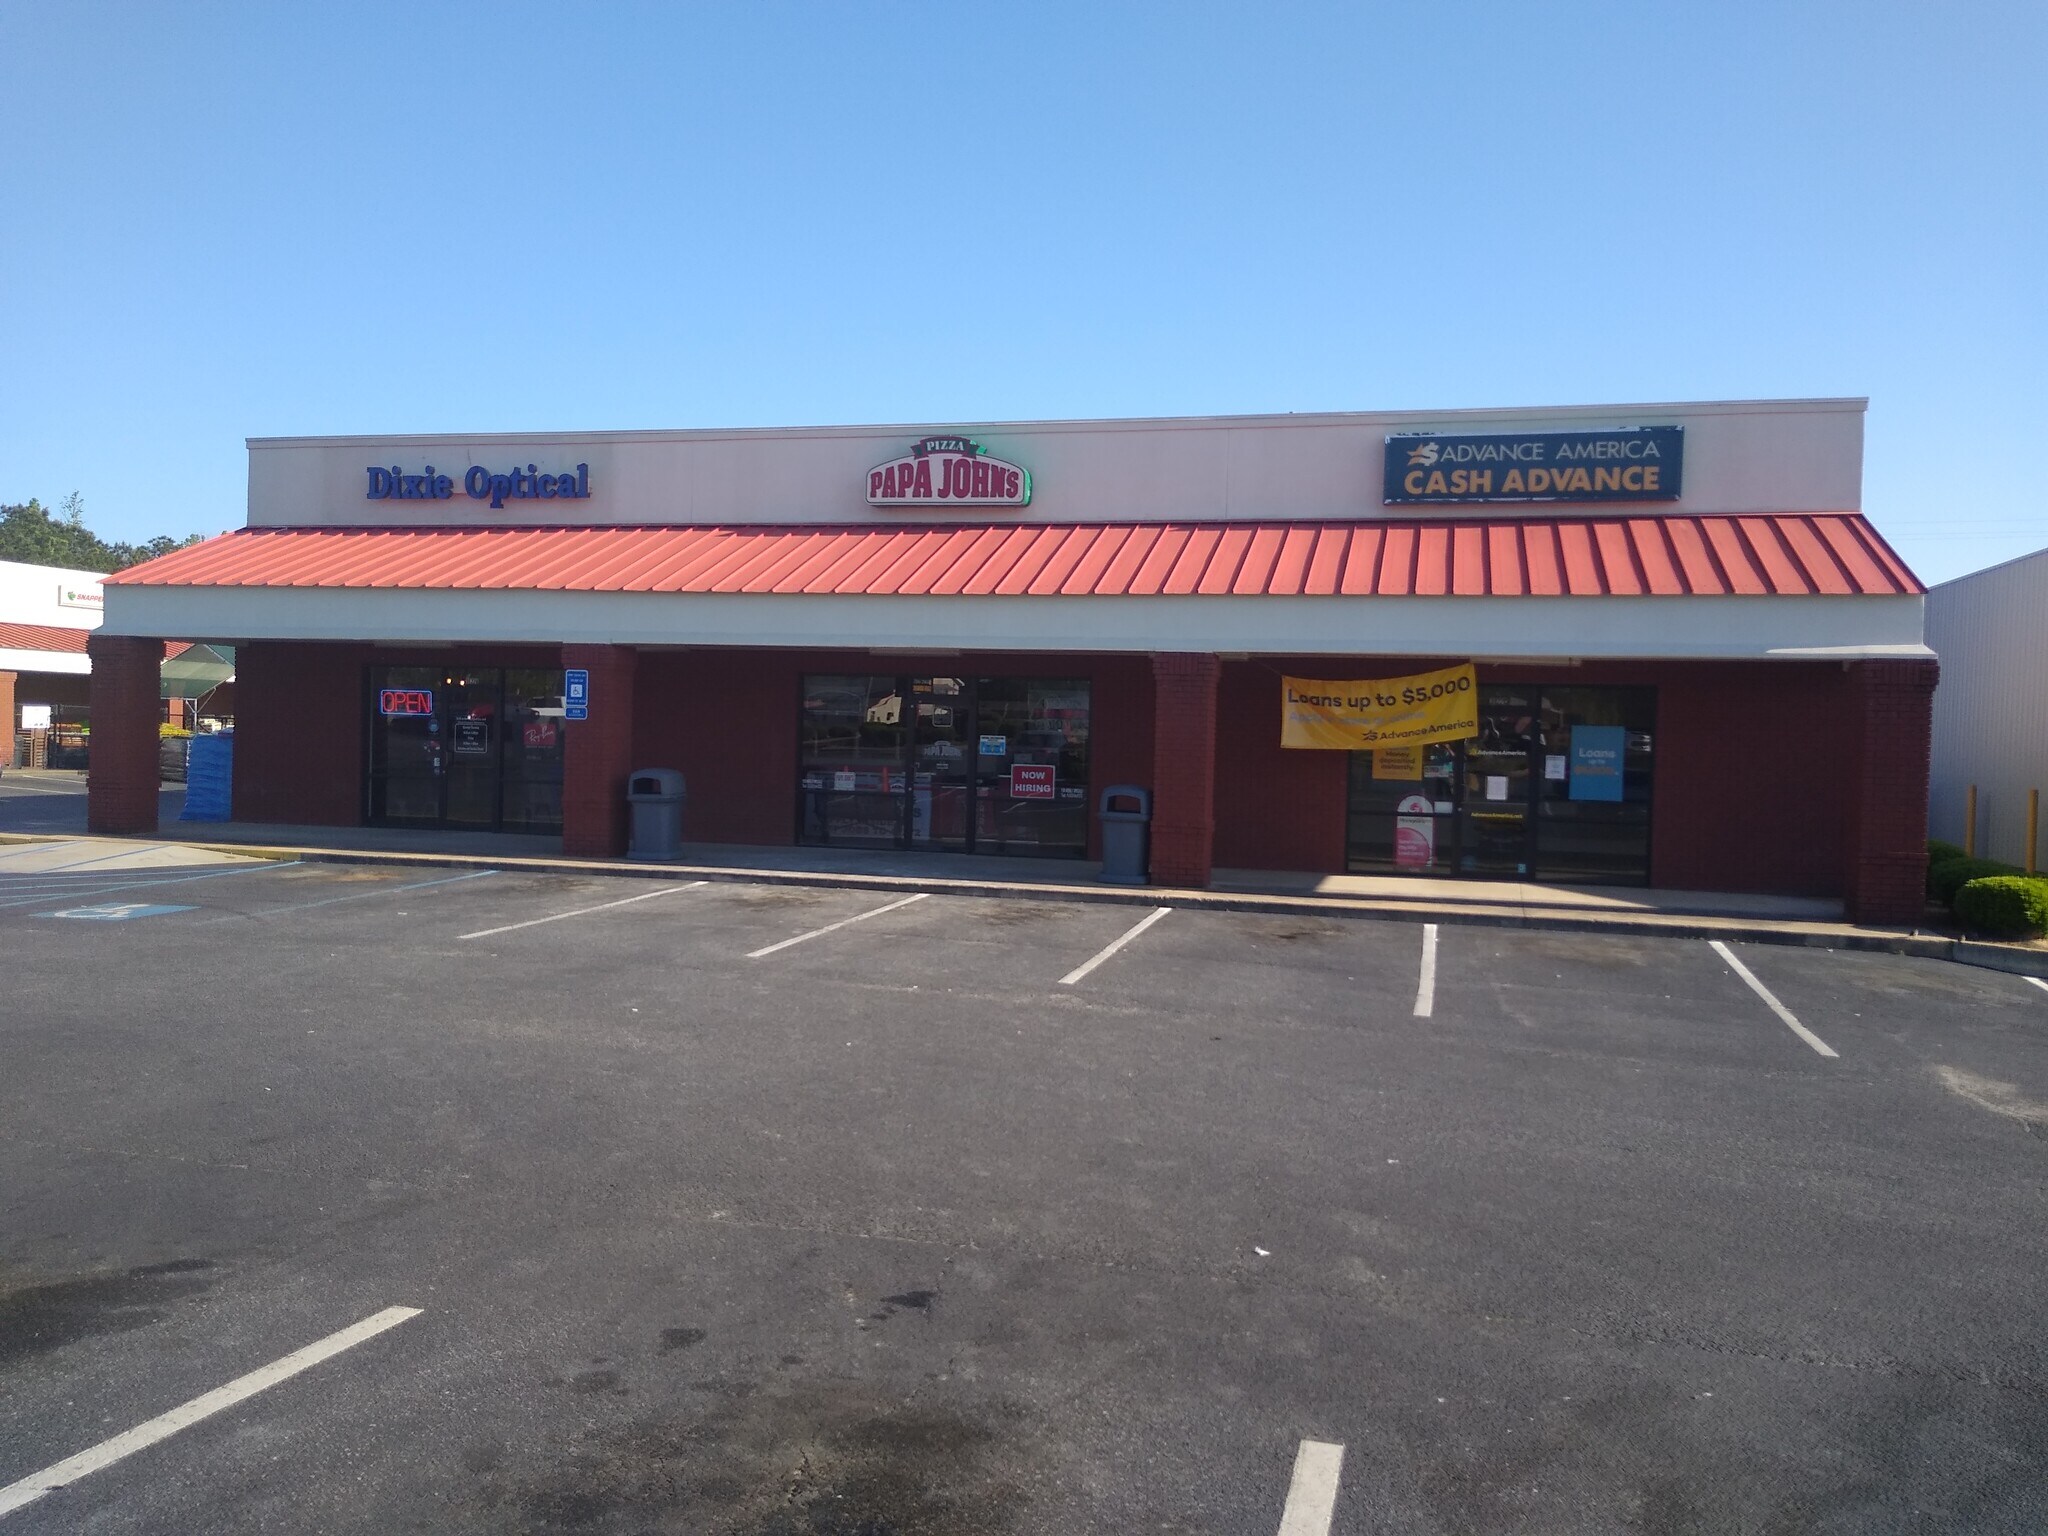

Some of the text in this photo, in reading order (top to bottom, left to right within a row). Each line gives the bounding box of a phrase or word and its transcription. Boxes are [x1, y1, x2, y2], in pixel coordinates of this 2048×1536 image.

[926, 440, 965, 452] PIZZA
[1440, 439, 1660, 463] ADVANCE AMERICA
[367, 462, 591, 508] Dixie Optical
[870, 458, 1019, 499] PAPA JOHN'S
[1404, 466, 1660, 495] CASH ADVANCE
[77, 594, 104, 602] SNAPPE
[383, 691, 431, 713] OPEN
[1287, 687, 1342, 708] Loans
[1347, 695, 1371, 712] up
[1375, 693, 1397, 707] to
[1402, 676, 1471, 706] $5,000
[1379, 718, 1475, 740] AdvanceAmerica
[1578, 747, 1617, 759] Loans
[1021, 771, 1046, 780] NOW
[1015, 783, 1051, 793] HIRING
